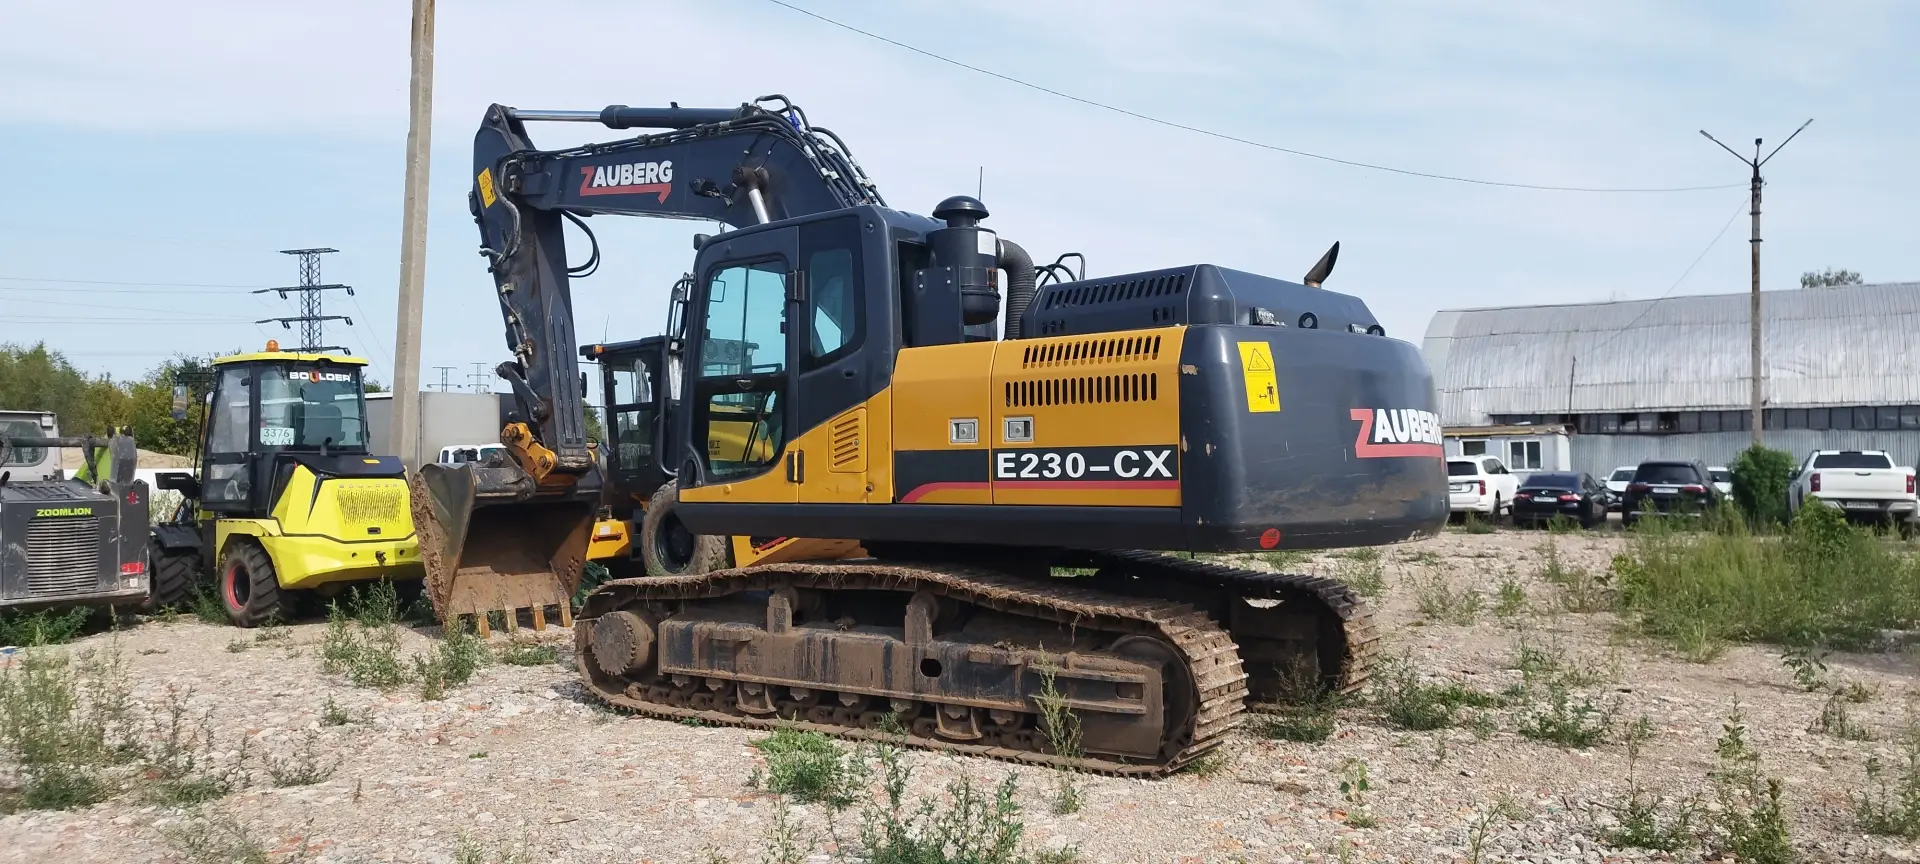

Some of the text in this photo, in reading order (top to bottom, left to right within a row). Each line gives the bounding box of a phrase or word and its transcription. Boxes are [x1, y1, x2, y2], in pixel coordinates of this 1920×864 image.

[580, 160, 673, 201] ZAUBERG
[289, 369, 351, 384] BOULDER
[263, 428, 290, 438] 3376
[997, 449, 1173, 478] E230-CX
[36, 507, 92, 517] ZOOMLION
